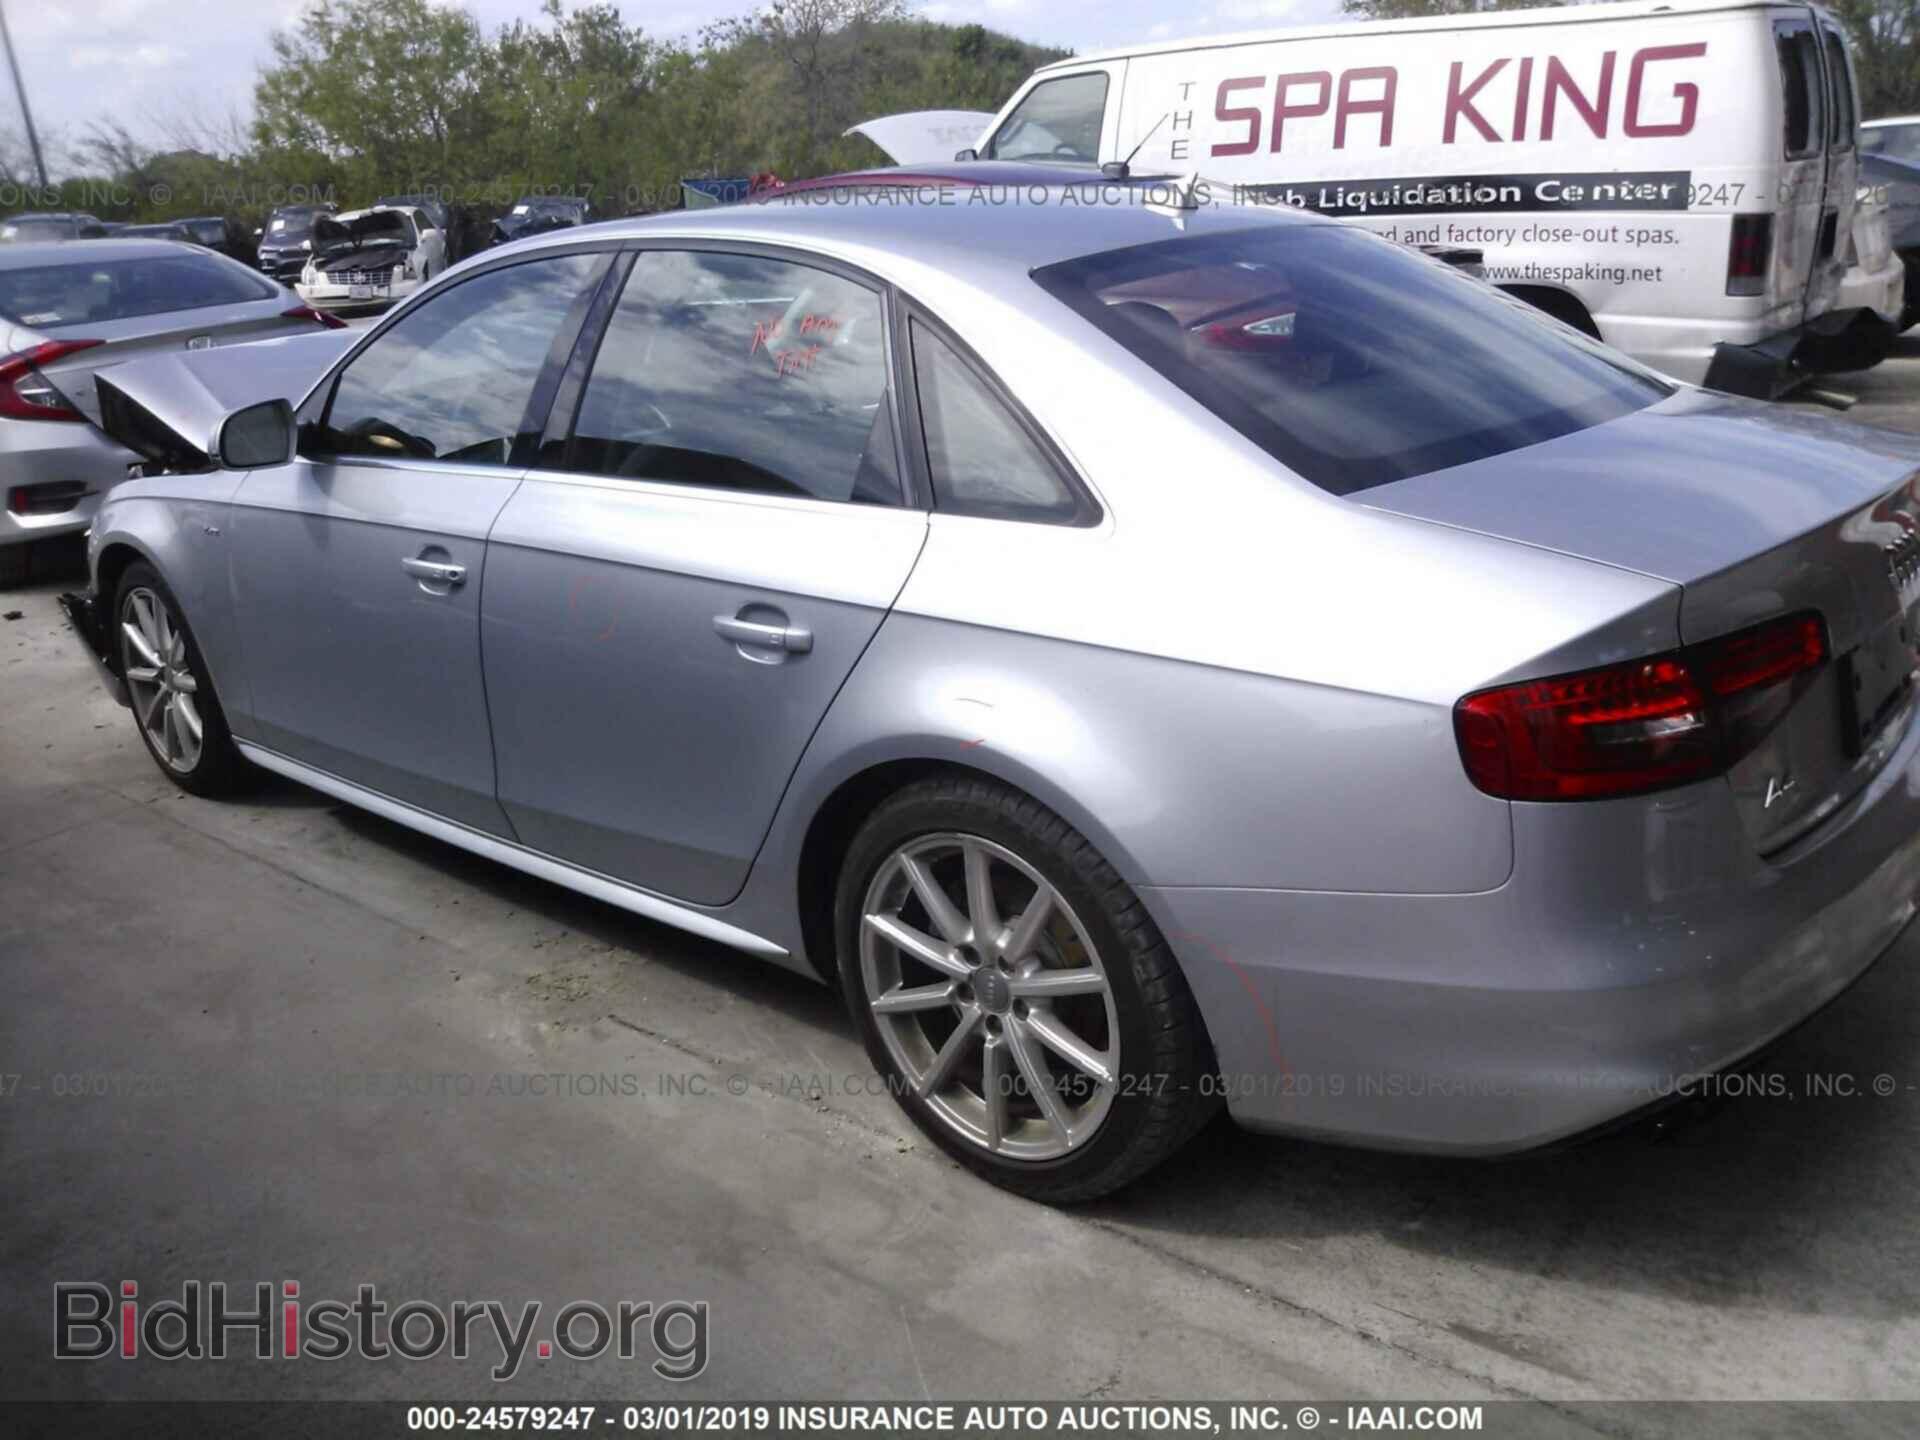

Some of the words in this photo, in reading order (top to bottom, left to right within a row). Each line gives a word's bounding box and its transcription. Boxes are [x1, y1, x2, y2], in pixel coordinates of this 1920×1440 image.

[1171, 81, 1197, 160] THE
[1211, 67, 1398, 157] SPA
[1442, 42, 1707, 145] KING
[1319, 182, 1522, 214] Liquidation
[1535, 179, 1679, 202] Center
[1405, 225, 1439, 243] and
[1448, 224, 1516, 247] factory
[1522, 224, 1618, 242] close-out
[1625, 228, 1679, 248] spas.
